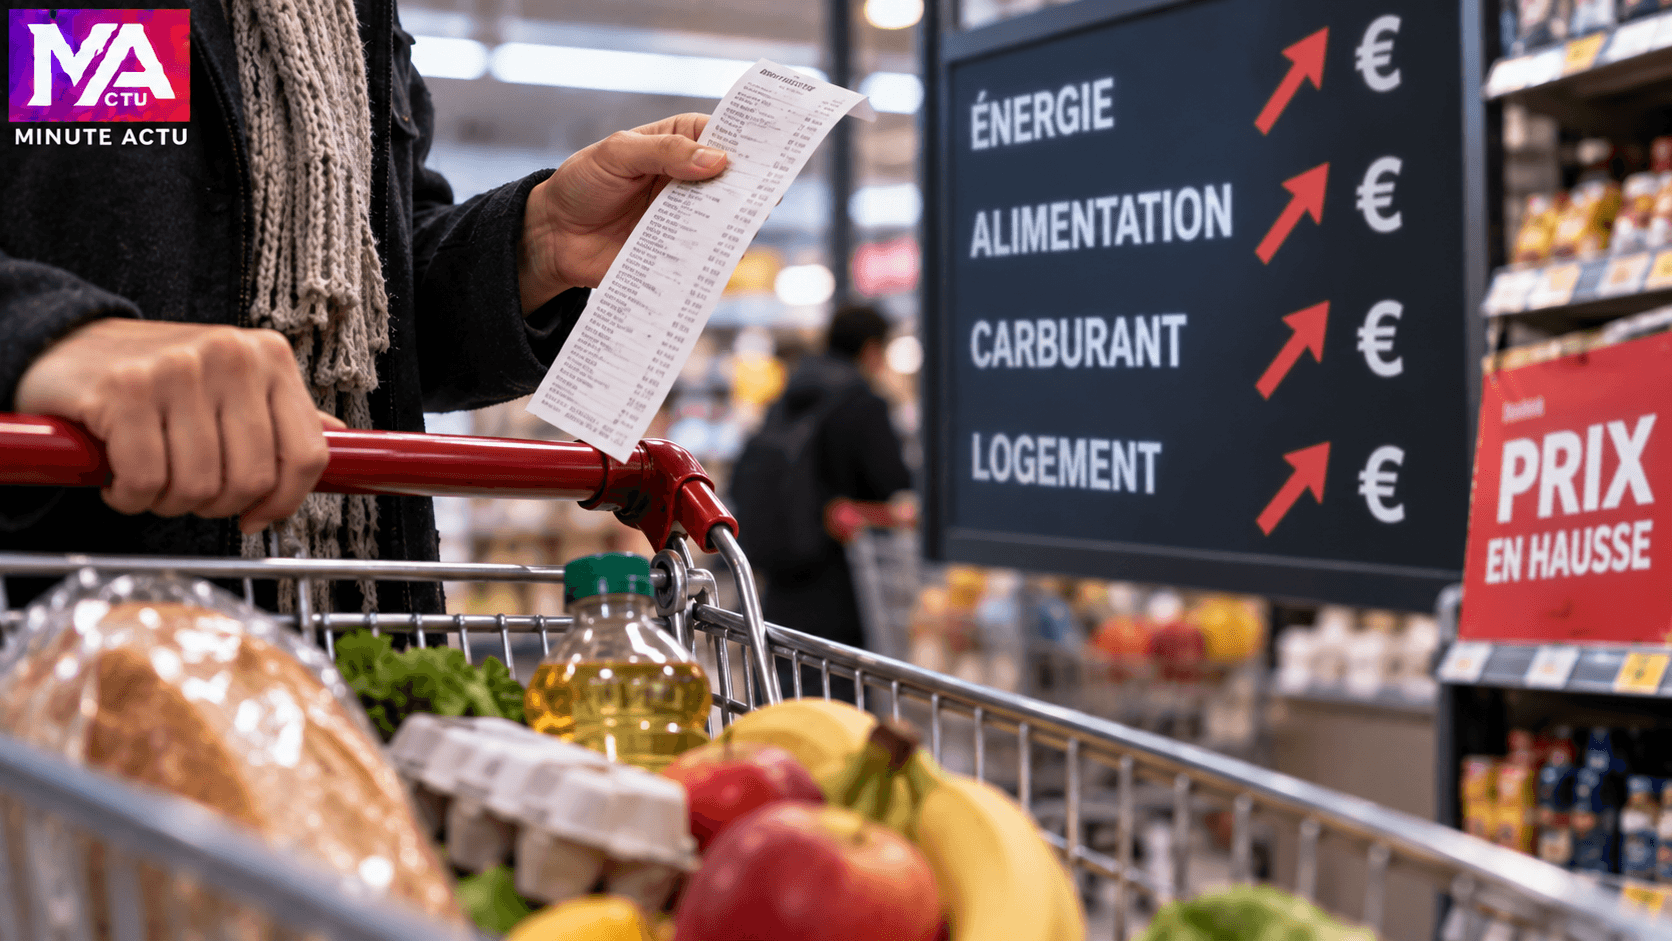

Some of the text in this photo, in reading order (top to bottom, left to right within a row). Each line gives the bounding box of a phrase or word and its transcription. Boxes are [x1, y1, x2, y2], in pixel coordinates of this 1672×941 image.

[971, 15, 1401, 150] ÉNERGIE €
[970, 156, 1402, 258] ALIMENTATION €
[970, 300, 1403, 377] CARBURANT €
[972, 433, 1404, 523] LOGEMENT €
[1497, 413, 1656, 523] PRIX
[1485, 519, 1653, 583] EN HAUSSE
